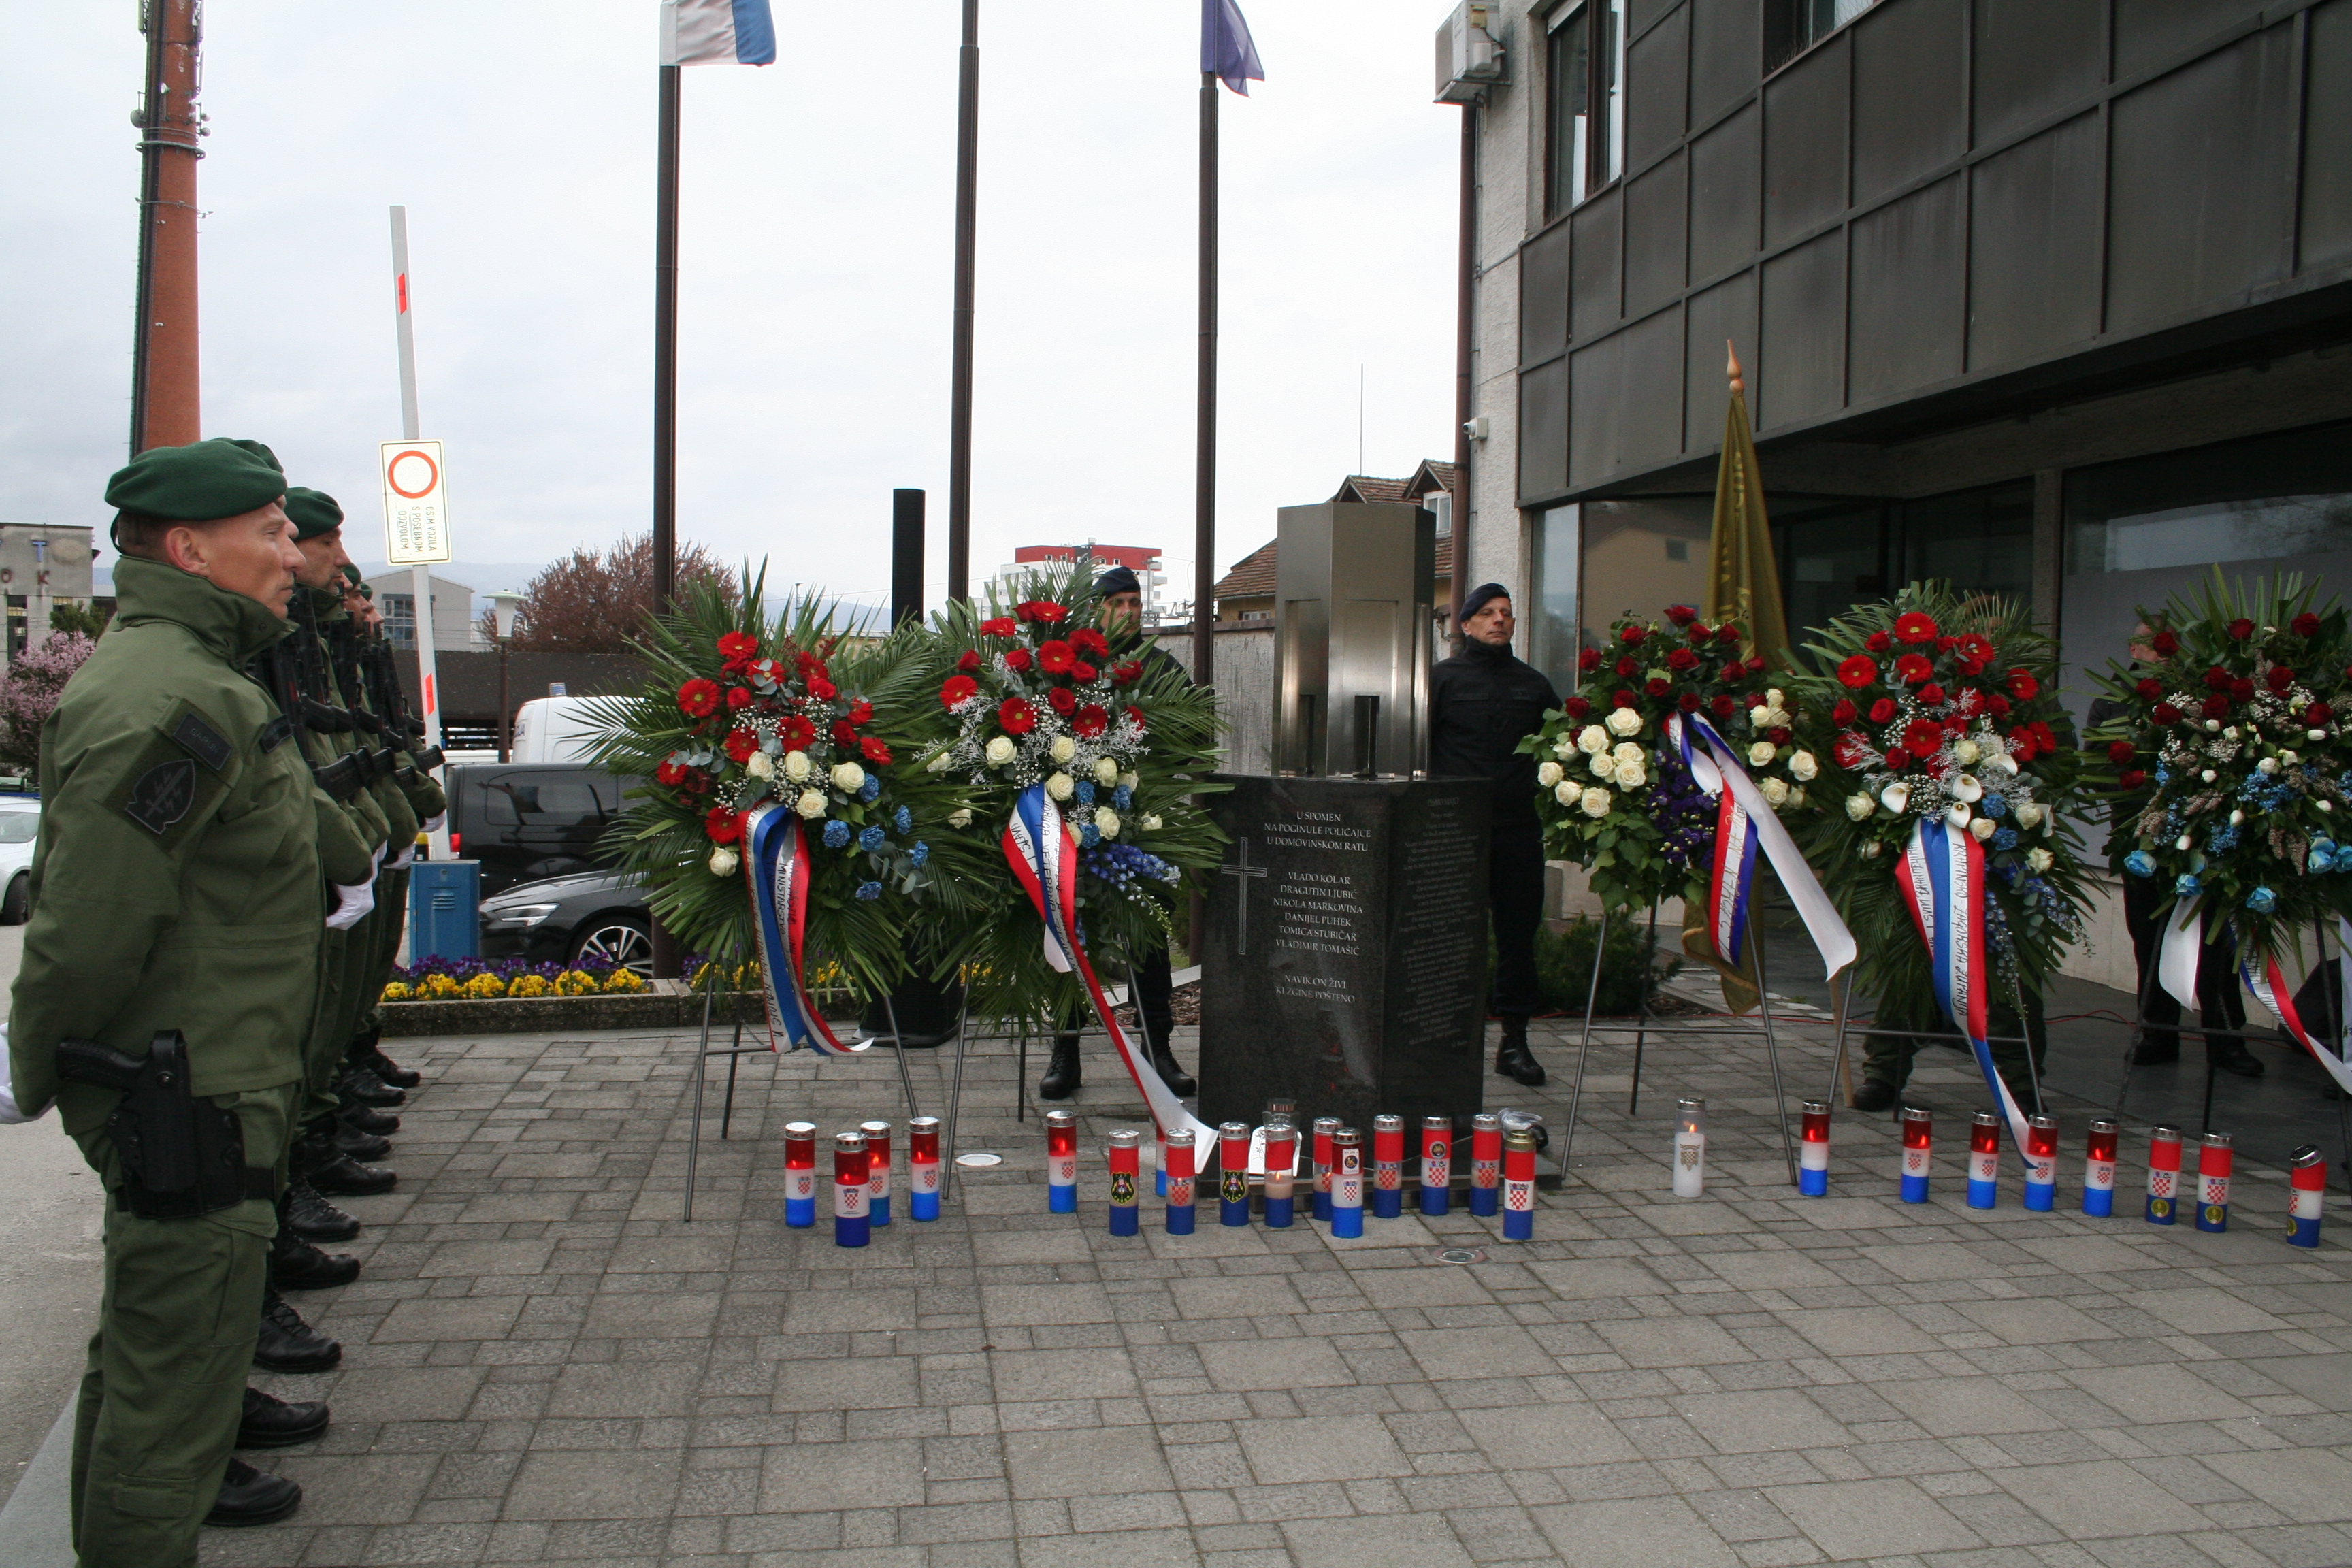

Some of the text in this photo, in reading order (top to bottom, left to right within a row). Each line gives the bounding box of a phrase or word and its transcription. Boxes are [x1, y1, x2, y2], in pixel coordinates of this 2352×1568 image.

[397, 511, 410, 549] DOZVOLOM
[412, 513, 423, 552] POSEBNOM
[425, 506, 437, 551] OSIM VOZILA
[1296, 811, 1341, 822] U SPOMEN
[1264, 823, 1371, 838] NA POGINULE POLICAJCE
[1267, 836, 1368, 852] U DOMOVINSKOM RATU
[1288, 871, 1350, 885] VLADO KOLAR
[777, 862, 787, 935] MINISTARSTVO
[1280, 884, 1358, 900] DRAGUTIN LJUBIĆ
[1273, 898, 1363, 914] NIKOLA MARKOVINA
[1284, 912, 1352, 927] DANIJEL PUHEK
[1278, 925, 1357, 941] TOMICA STUBIČAR
[1275, 938, 1360, 956] VLADIMIR TOMAŠIĆ
[1284, 974, 1346, 990] NAVIK ON ŽIVI
[1276, 986, 1355, 1003] KI ZGINE POŠTENO
